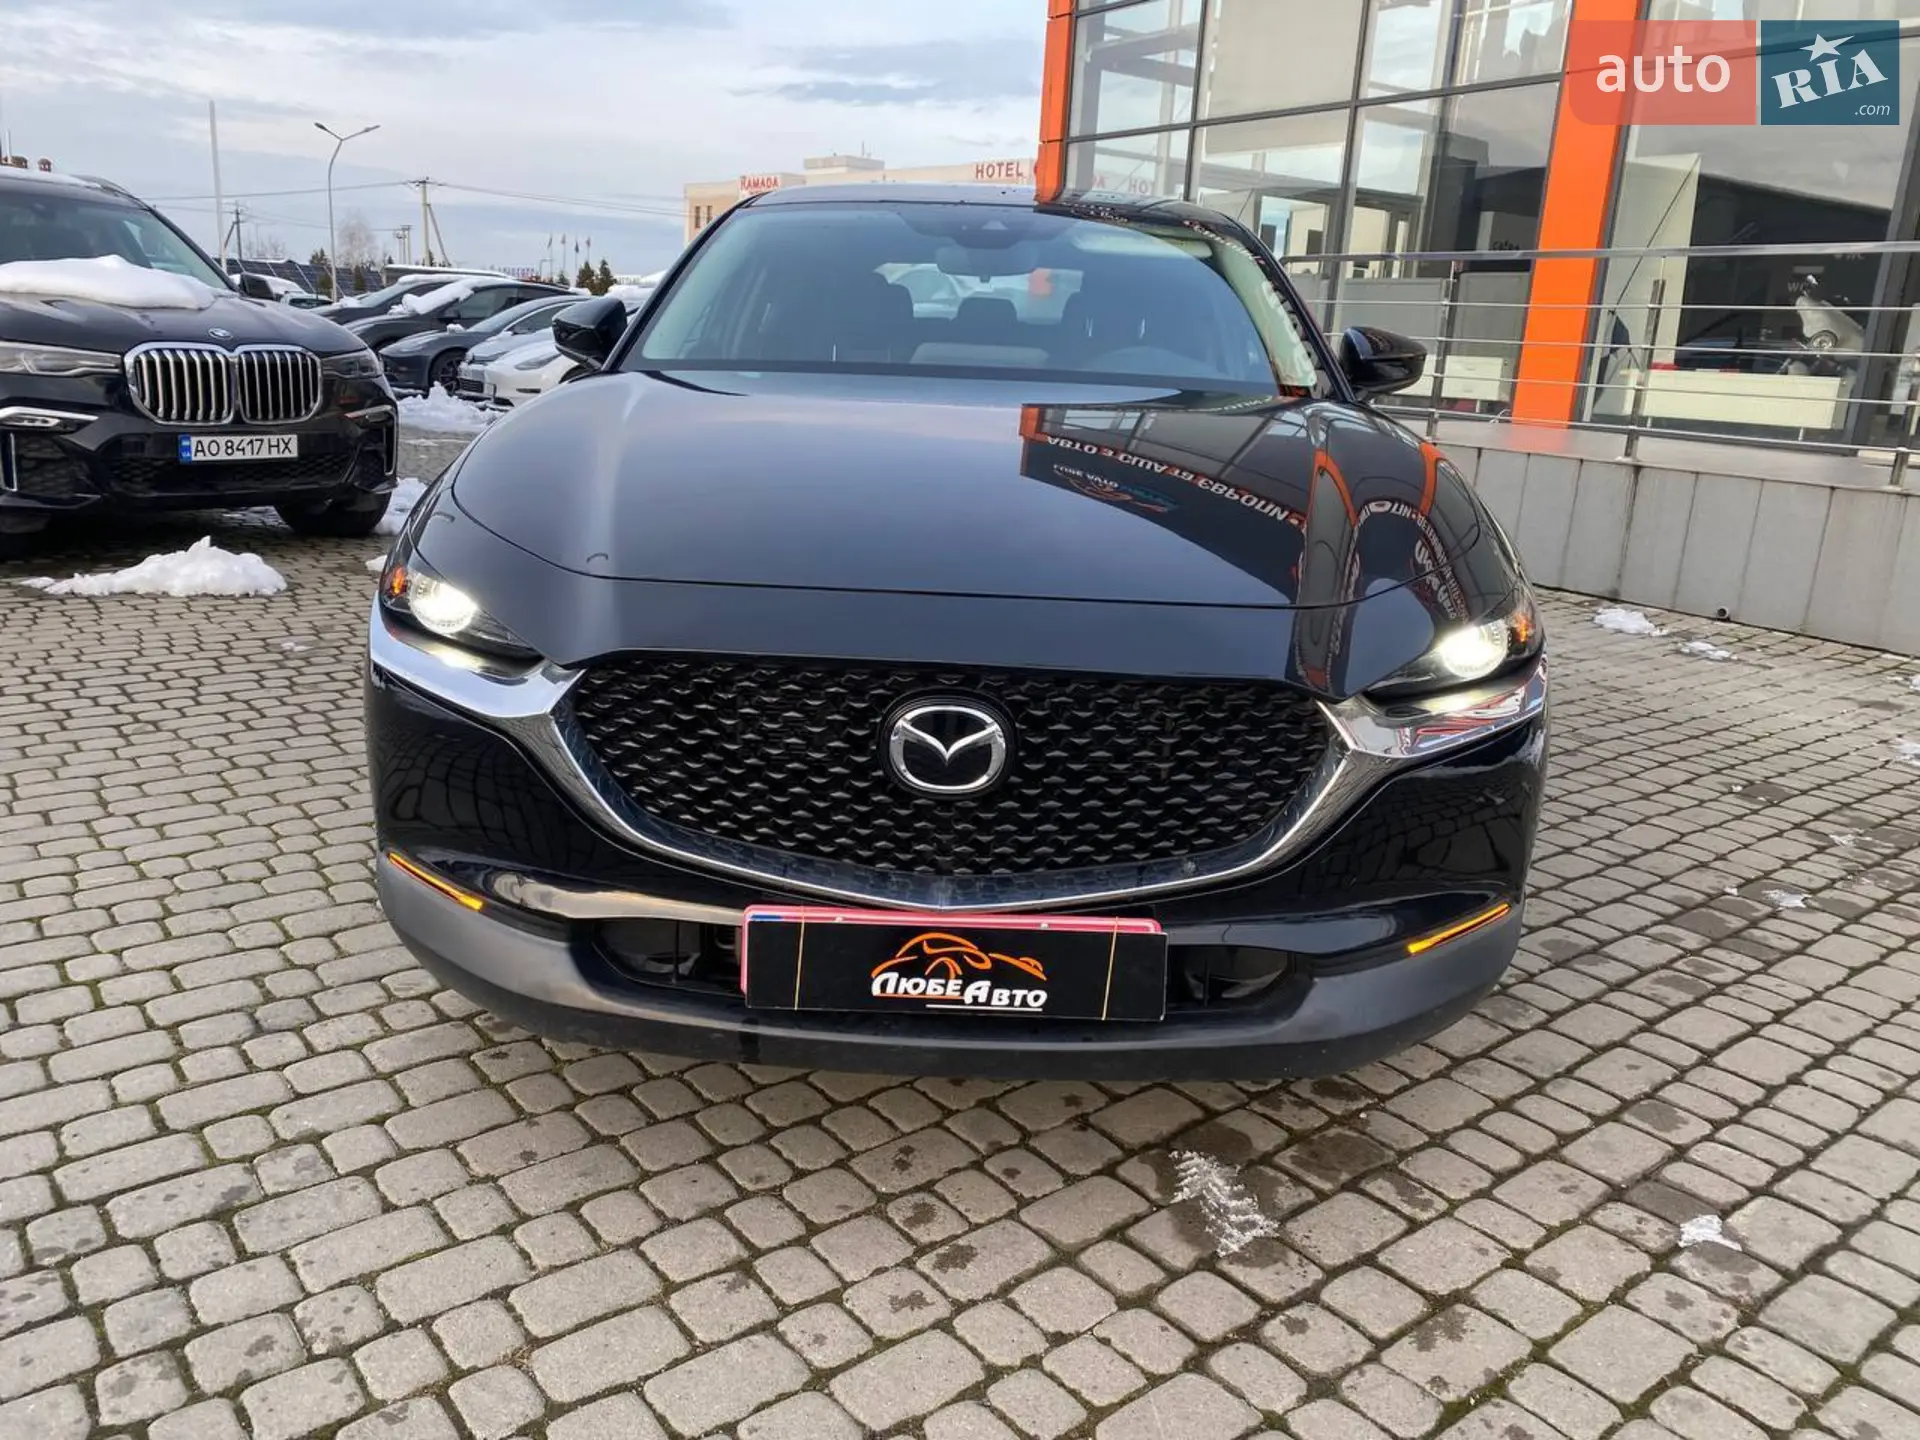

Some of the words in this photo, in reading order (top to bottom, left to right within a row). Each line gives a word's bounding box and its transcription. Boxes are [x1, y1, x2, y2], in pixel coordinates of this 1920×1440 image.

[975, 162, 1023, 179] HOTEL
[194, 439, 221, 457] AO
[224, 438, 265, 457] 8417
[267, 437, 292, 455] HX
